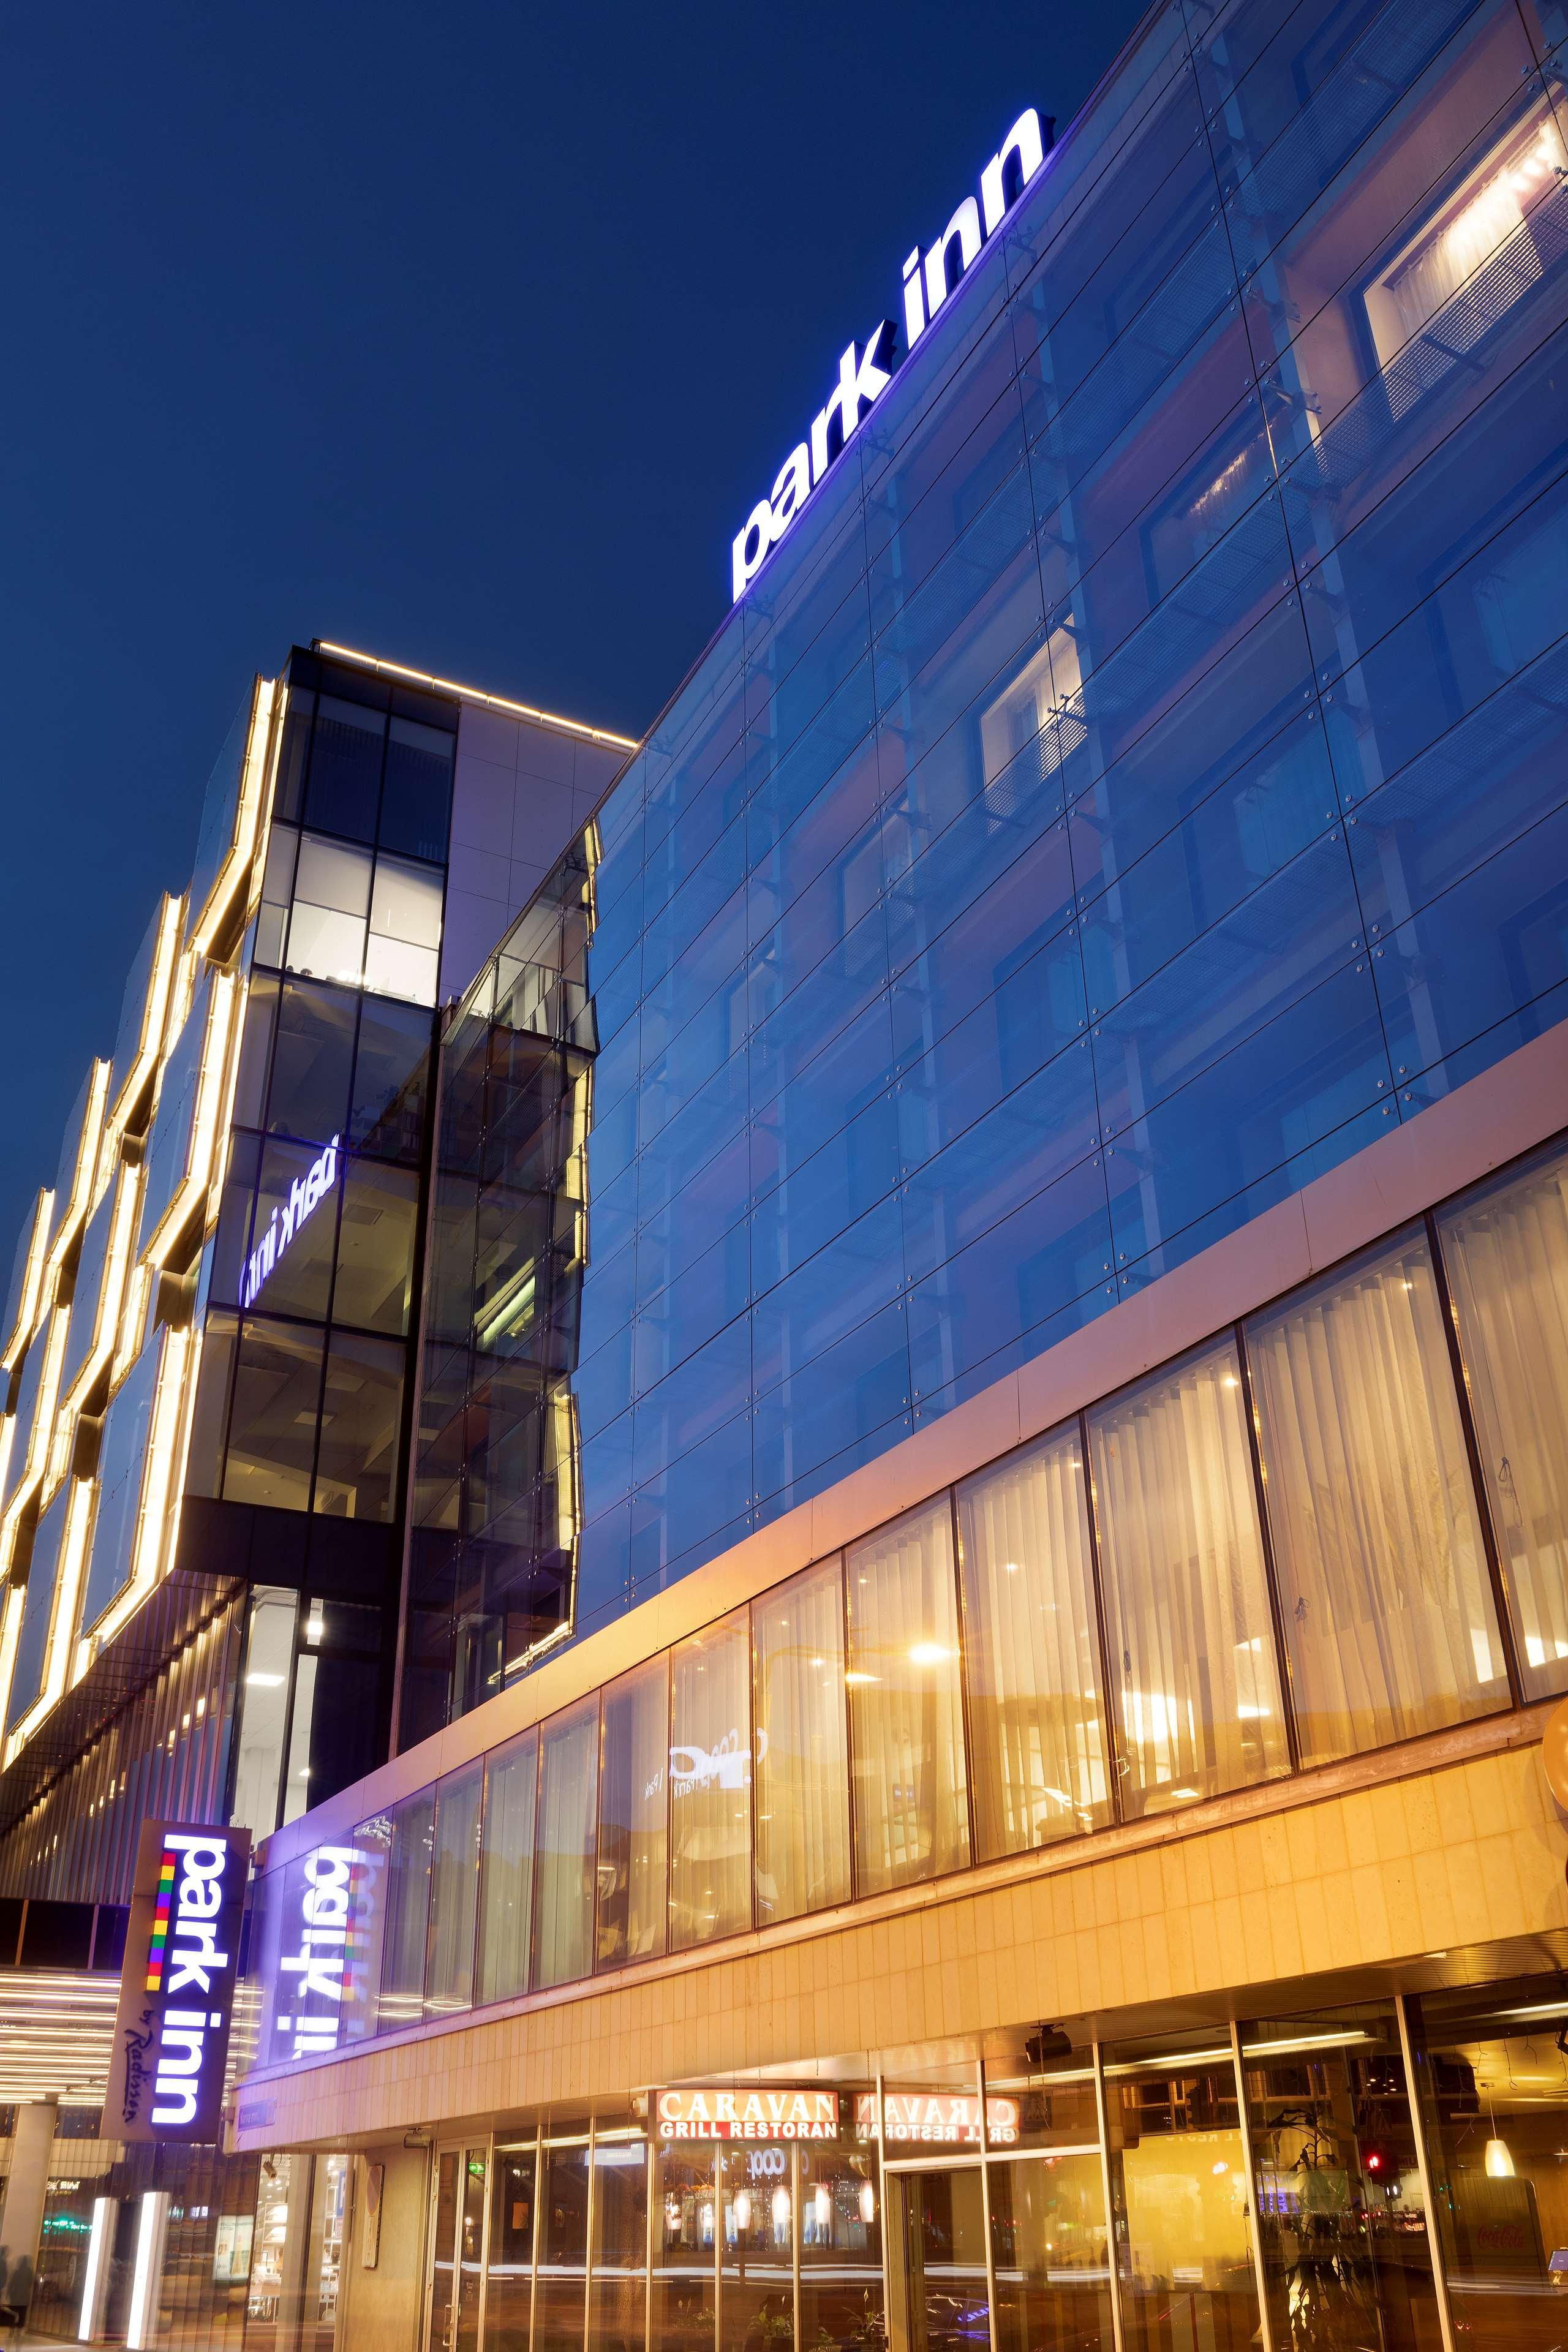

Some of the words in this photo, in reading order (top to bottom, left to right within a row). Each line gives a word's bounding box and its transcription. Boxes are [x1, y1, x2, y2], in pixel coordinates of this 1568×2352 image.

[733, 320, 891, 605] park
[902, 108, 1043, 351] inn
[164, 1834, 228, 1994] park
[139, 2010, 154, 2026] by
[123, 2029, 153, 2124] Radisson
[151, 2010, 221, 2124] inn
[659, 2093, 835, 2121] CARAVAN
[660, 2122, 722, 2138] GRILL
[729, 2122, 837, 2138] RESTORAN
